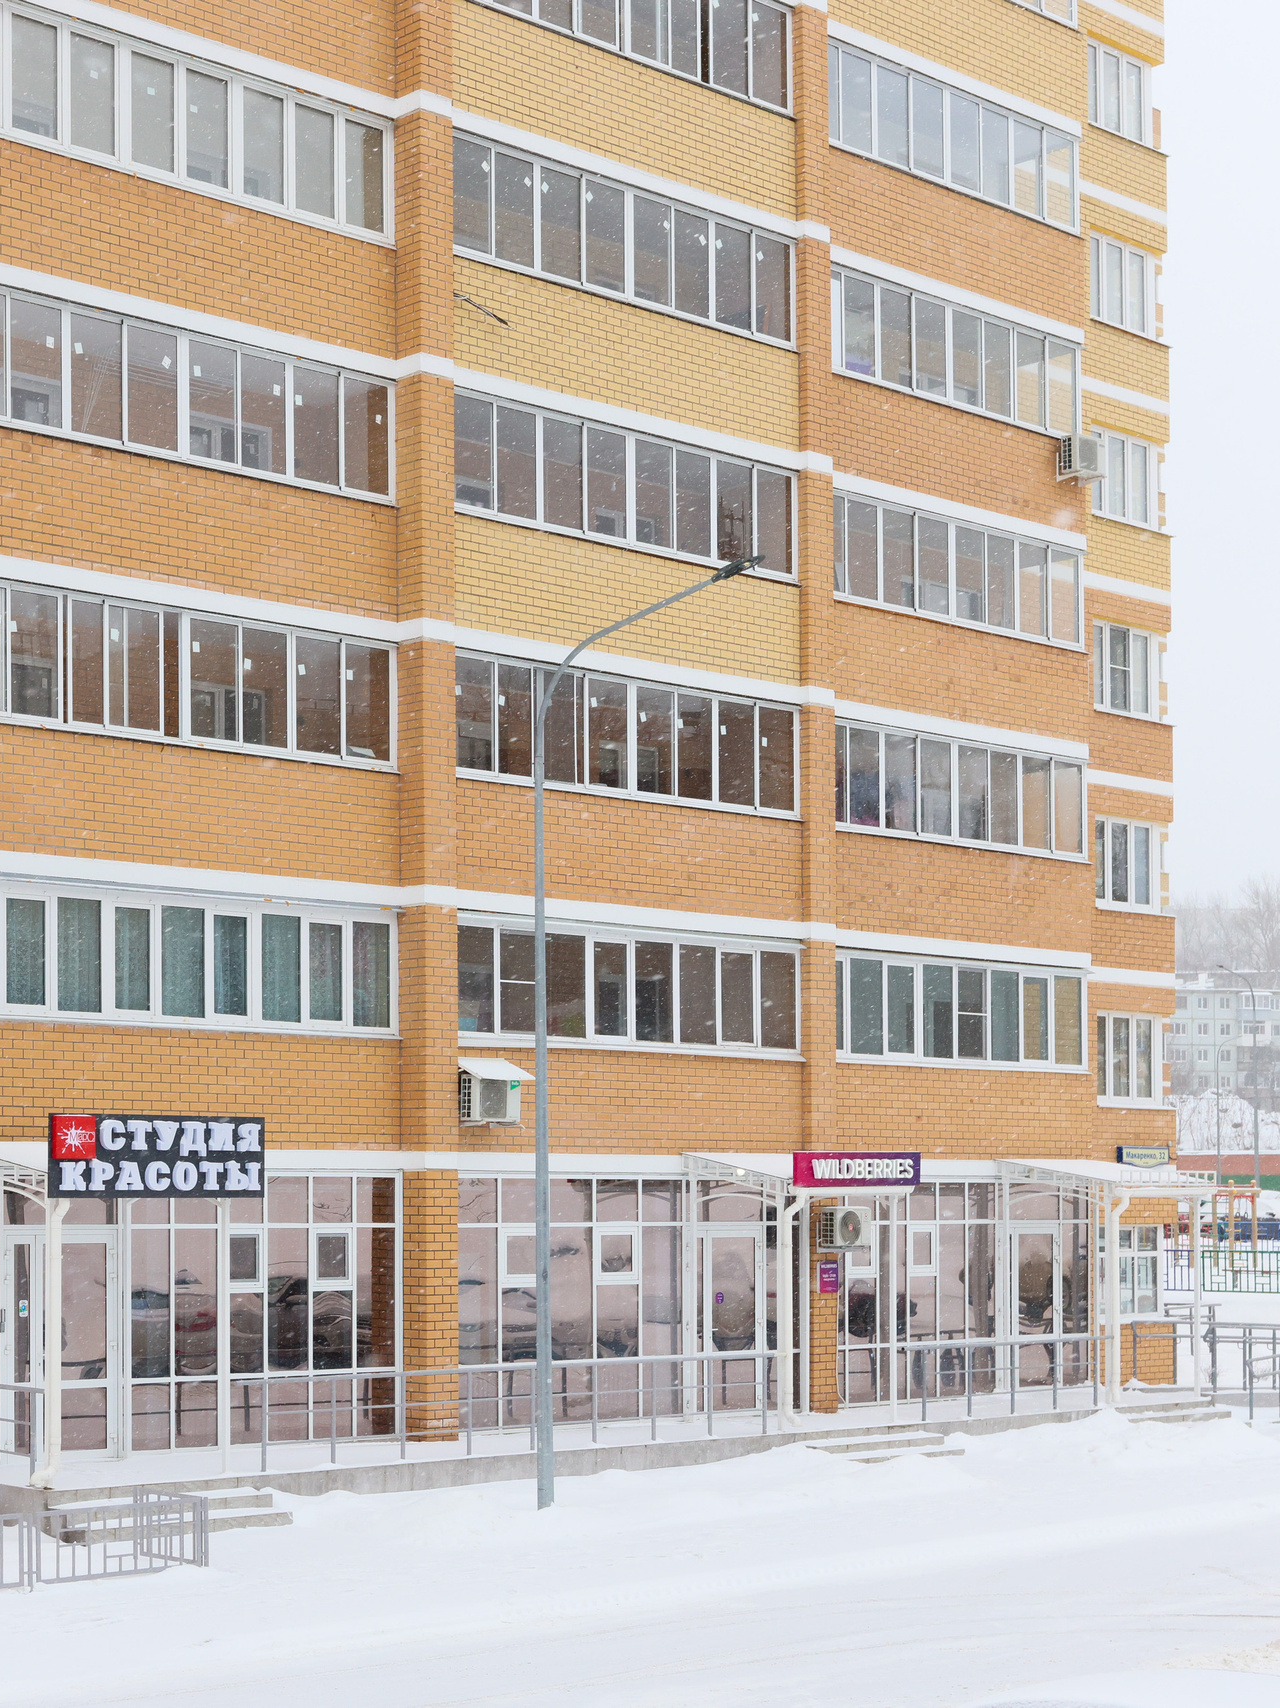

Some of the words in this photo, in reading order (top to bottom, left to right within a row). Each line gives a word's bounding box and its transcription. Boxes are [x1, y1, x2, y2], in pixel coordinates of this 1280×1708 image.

[100, 1120, 261, 1157] СТУДИЯ
[812, 1158, 914, 1179] WILDBERRIES
[1159, 1151, 1166, 1160] 32
[59, 1160, 261, 1191] КРАСОТЫ
